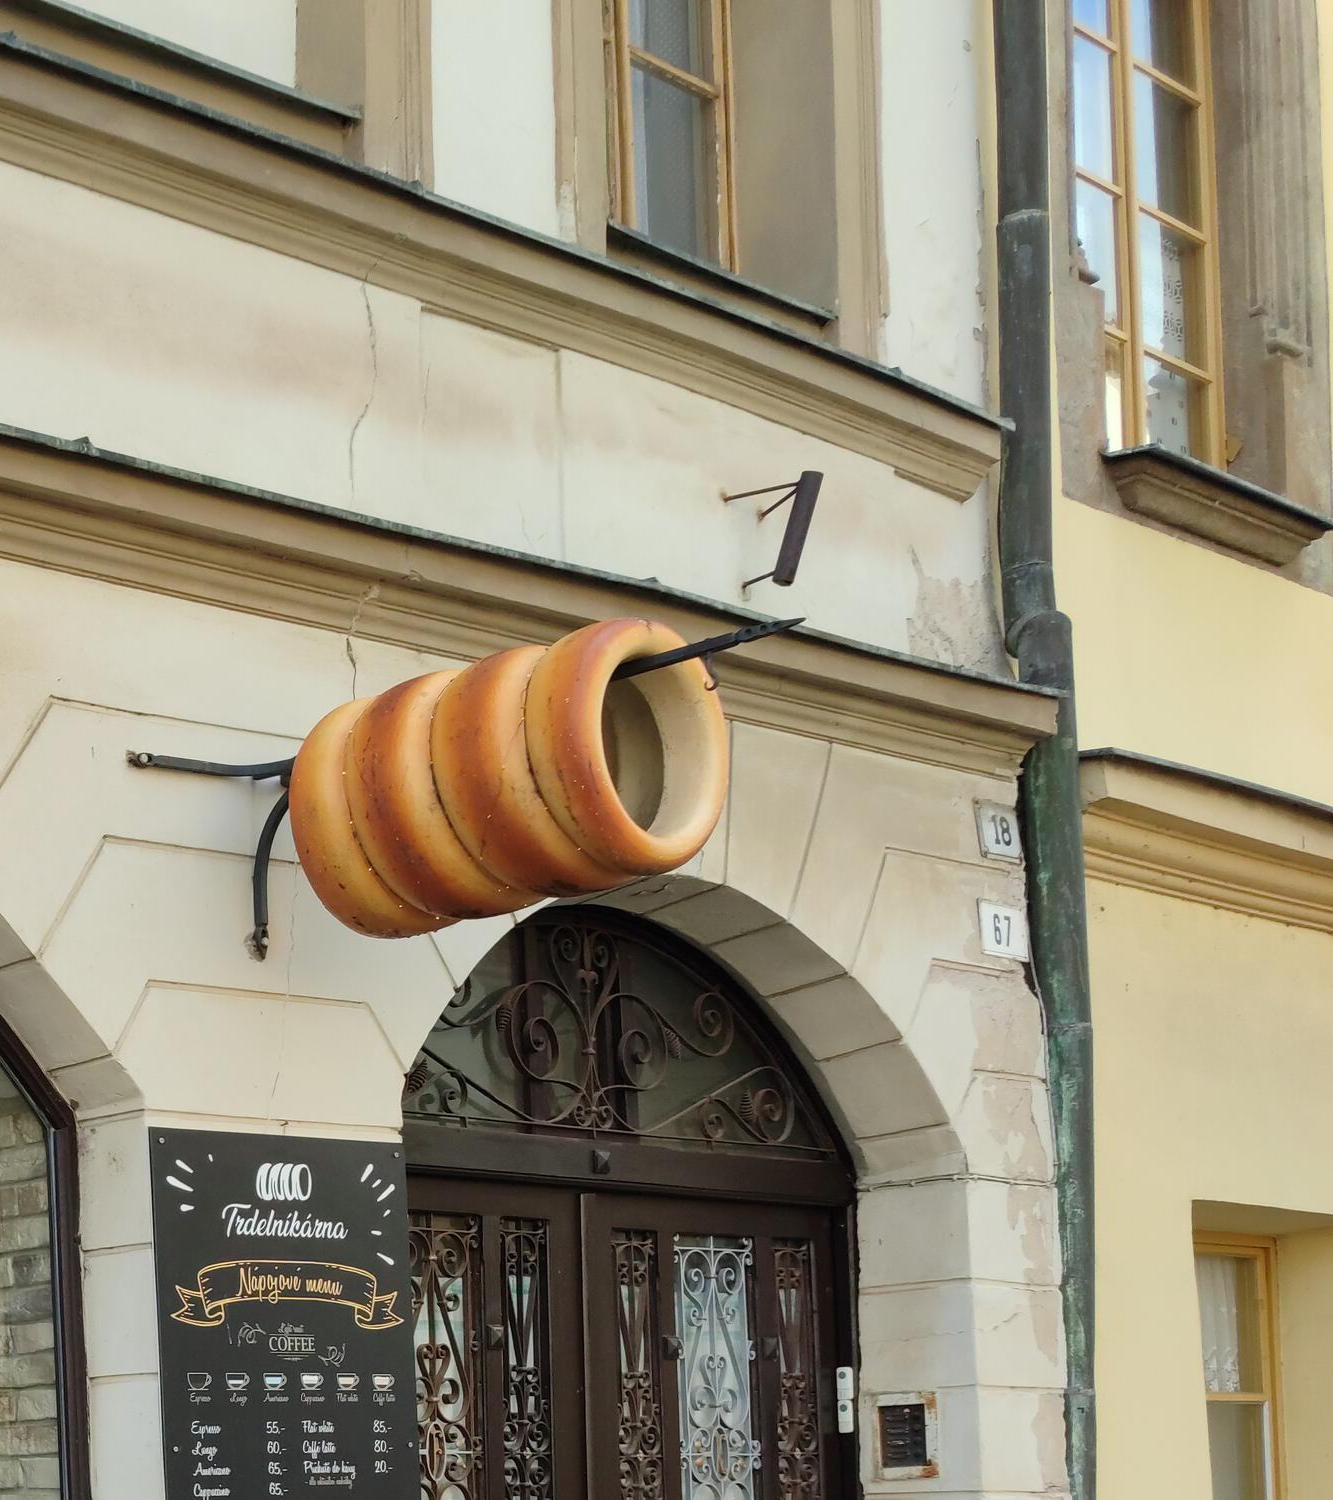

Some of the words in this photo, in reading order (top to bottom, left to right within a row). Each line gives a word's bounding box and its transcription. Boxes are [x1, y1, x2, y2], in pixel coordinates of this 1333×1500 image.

[991, 814, 1012, 846] 18
[993, 913, 1011, 947] 67
[221, 1203, 349, 1240] Trdelníkárna
[235, 1266, 302, 1304] Nápojové
[306, 1277, 343, 1297] menu
[269, 1336, 316, 1352] COFFEE
